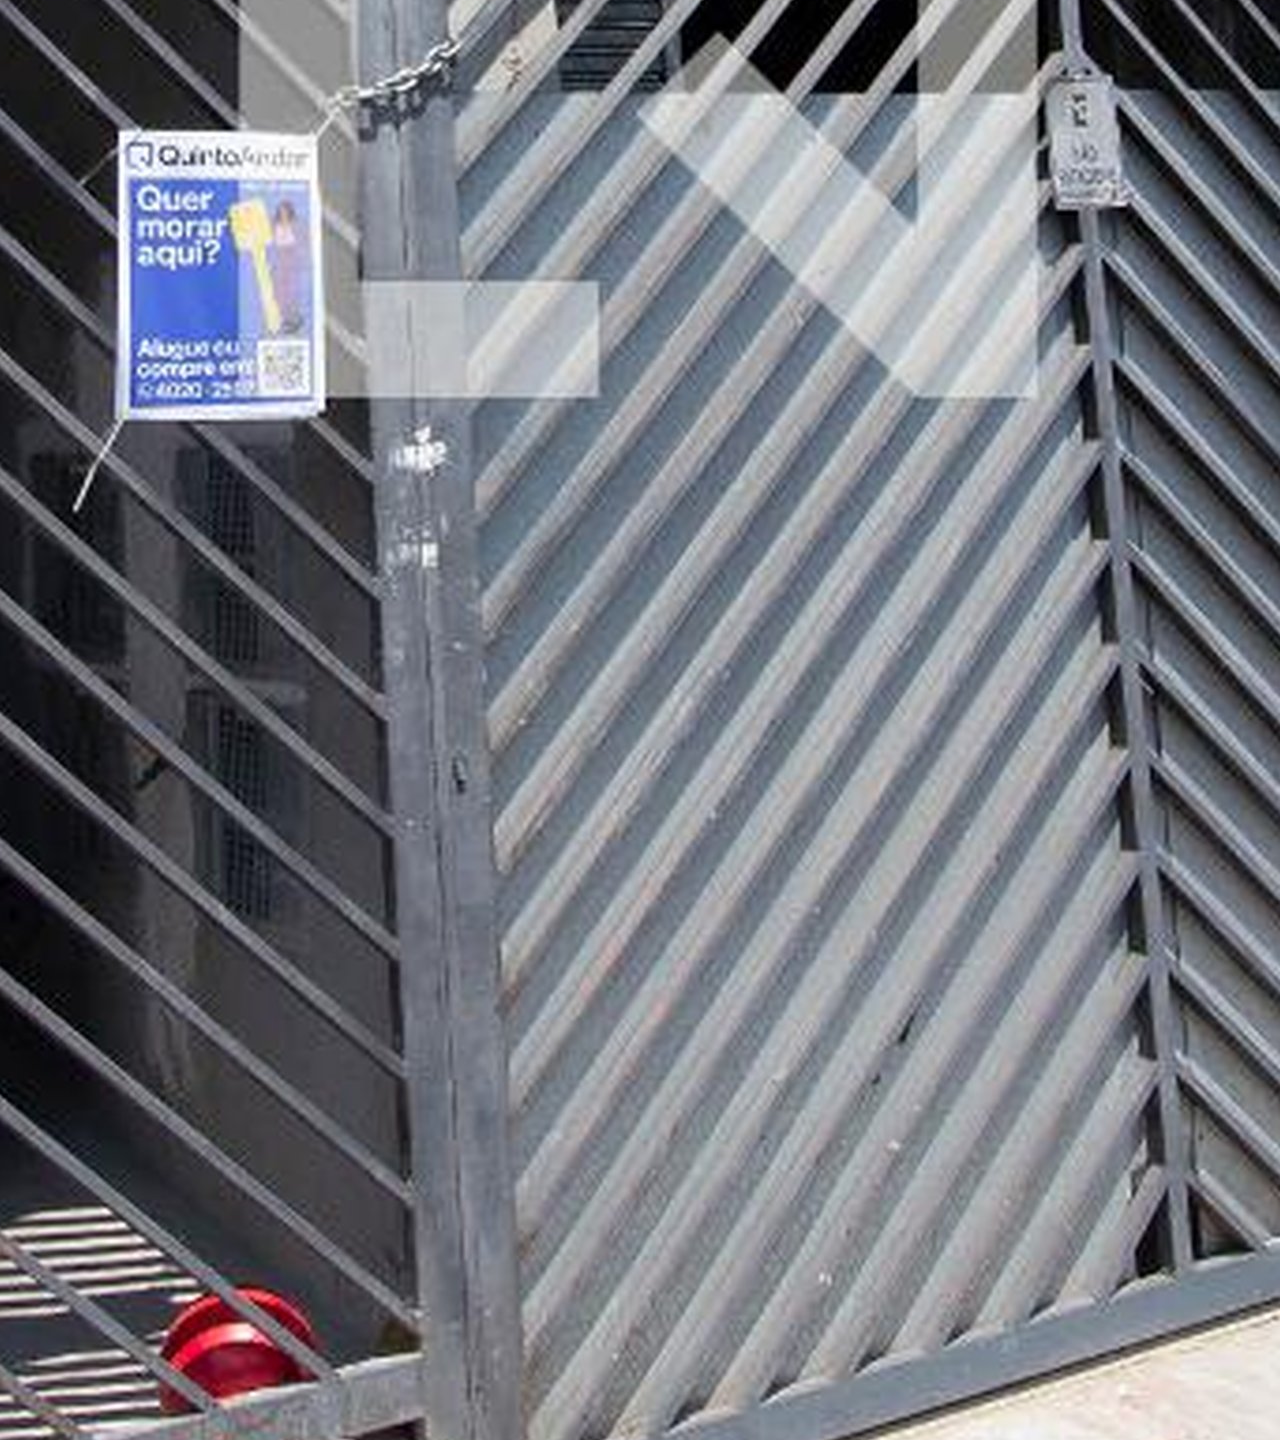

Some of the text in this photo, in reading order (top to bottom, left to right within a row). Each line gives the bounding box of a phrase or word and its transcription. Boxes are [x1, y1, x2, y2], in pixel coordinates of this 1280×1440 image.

[137, 184, 216, 211] Quer
[137, 218, 228, 240] morar
[137, 240, 221, 271] aqui?
[136, 362, 216, 379] compre
